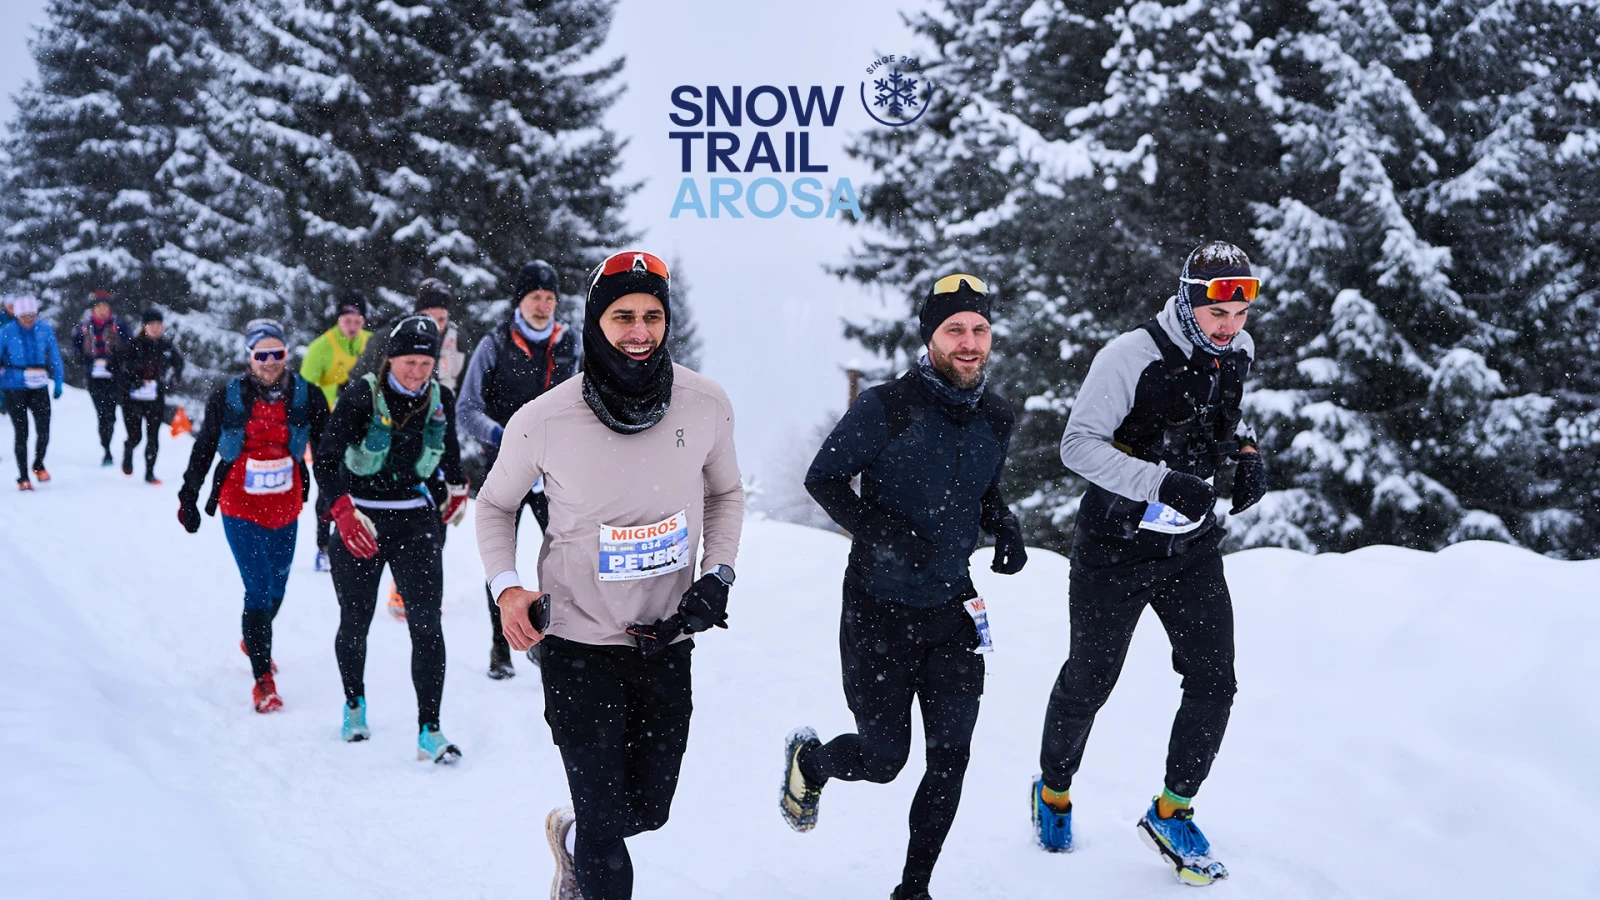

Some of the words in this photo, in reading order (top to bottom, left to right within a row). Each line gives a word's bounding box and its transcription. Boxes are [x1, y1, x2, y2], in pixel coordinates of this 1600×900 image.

[611, 517, 678, 541] MIGROS
[608, 544, 679, 571] PETER
[641, 540, 661, 551] 634
